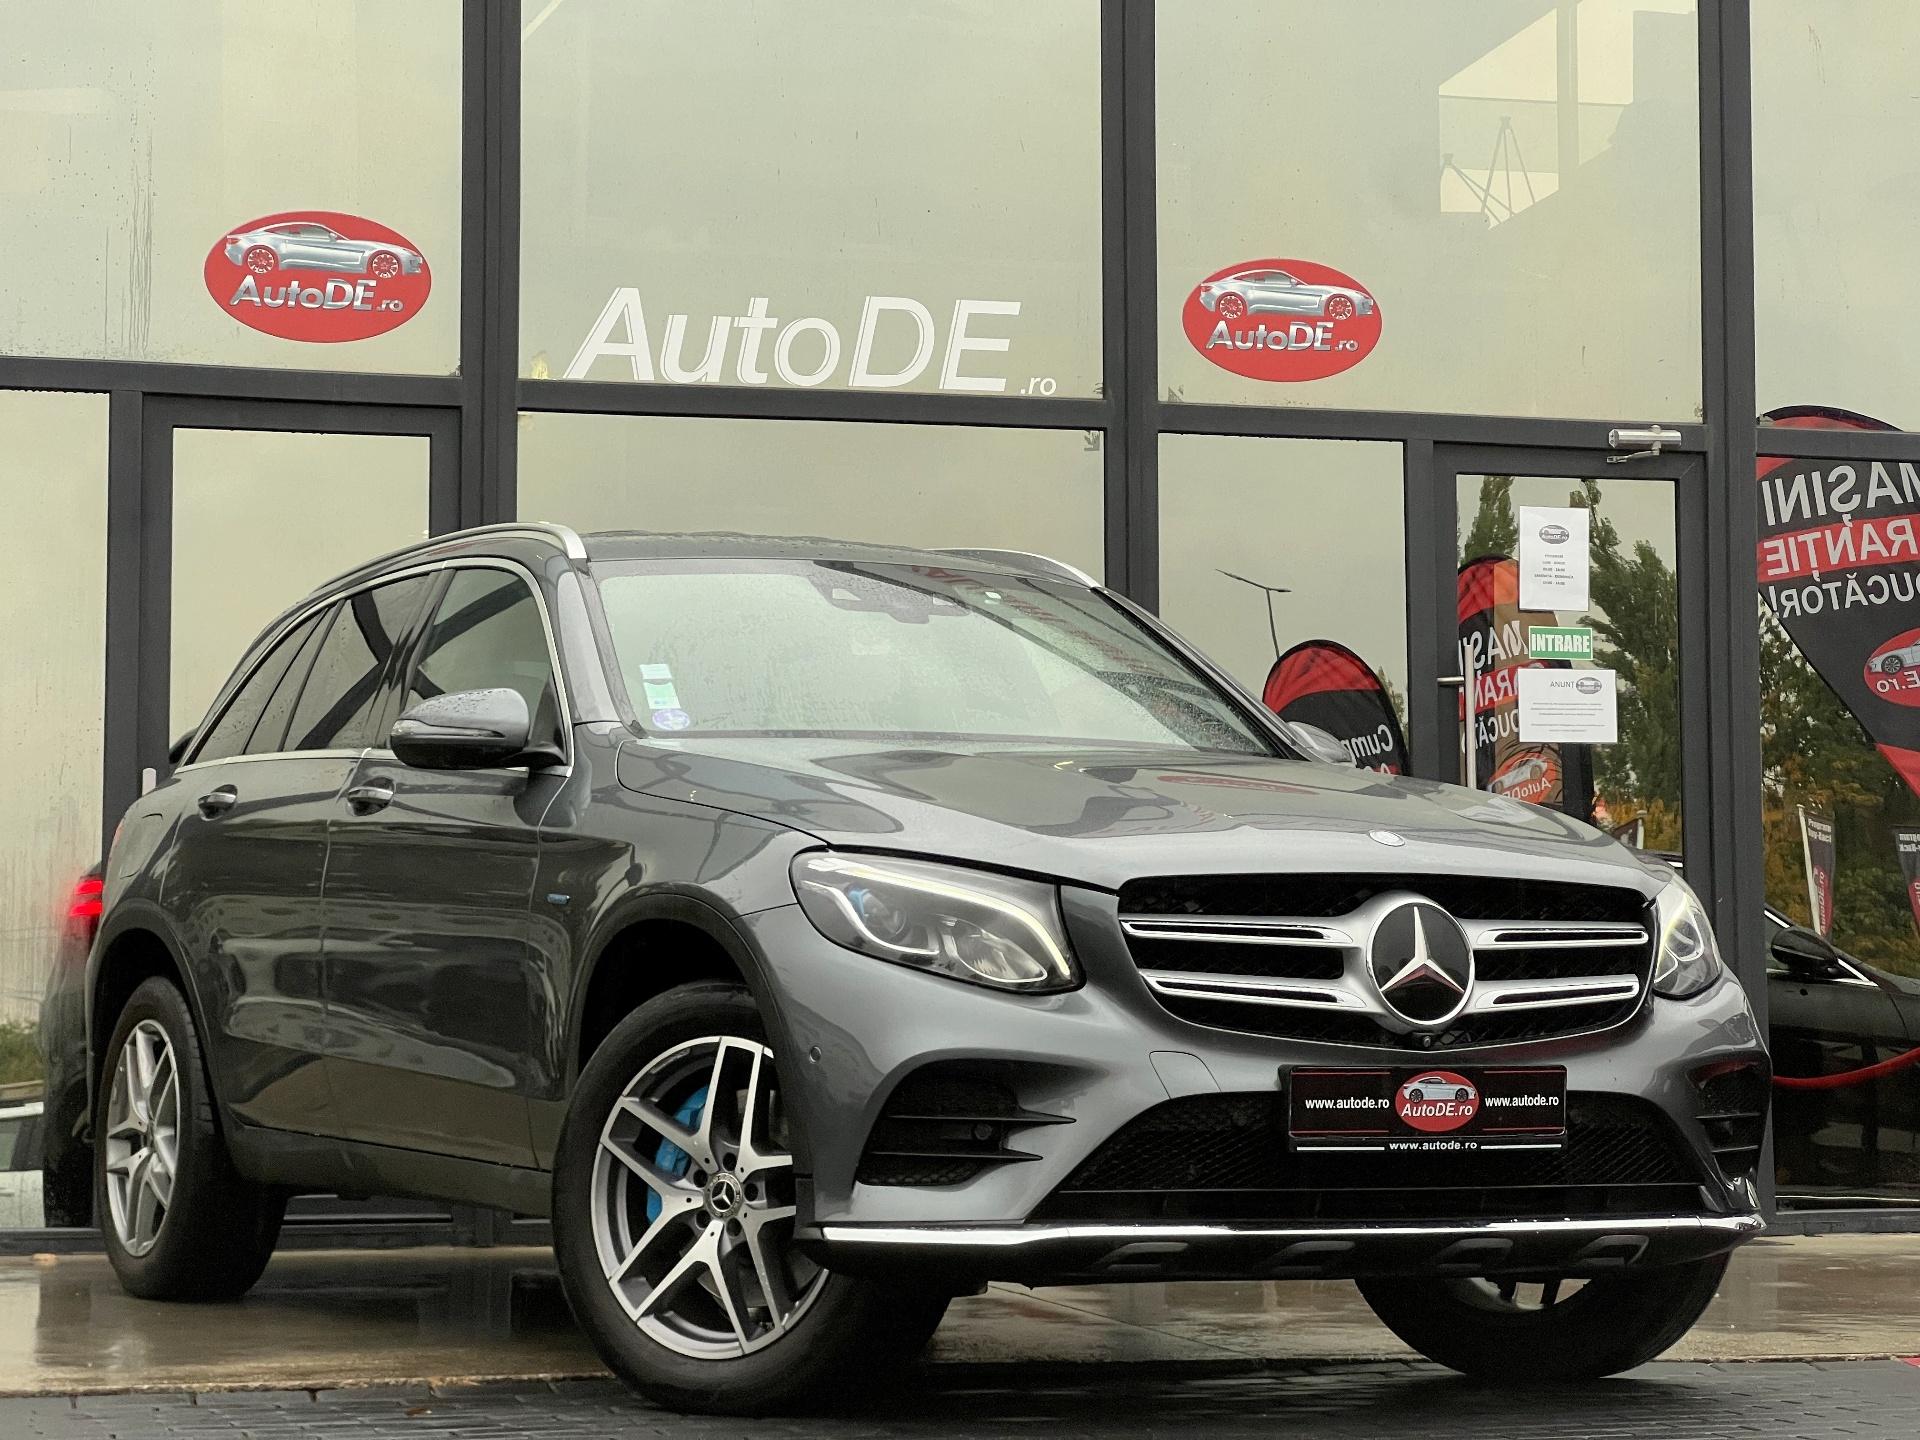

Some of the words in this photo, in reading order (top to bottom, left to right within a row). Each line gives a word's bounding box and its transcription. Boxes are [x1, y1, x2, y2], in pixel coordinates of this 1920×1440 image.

[1531, 633, 1591, 654] INTRARE
[1305, 1096, 1390, 1109] www.autode.ro
[1485, 1093, 1559, 1107] www.autode.ro
[1400, 1102, 1473, 1117] AutoDE.ro
[1389, 1140, 1478, 1151] www.autode.ro
